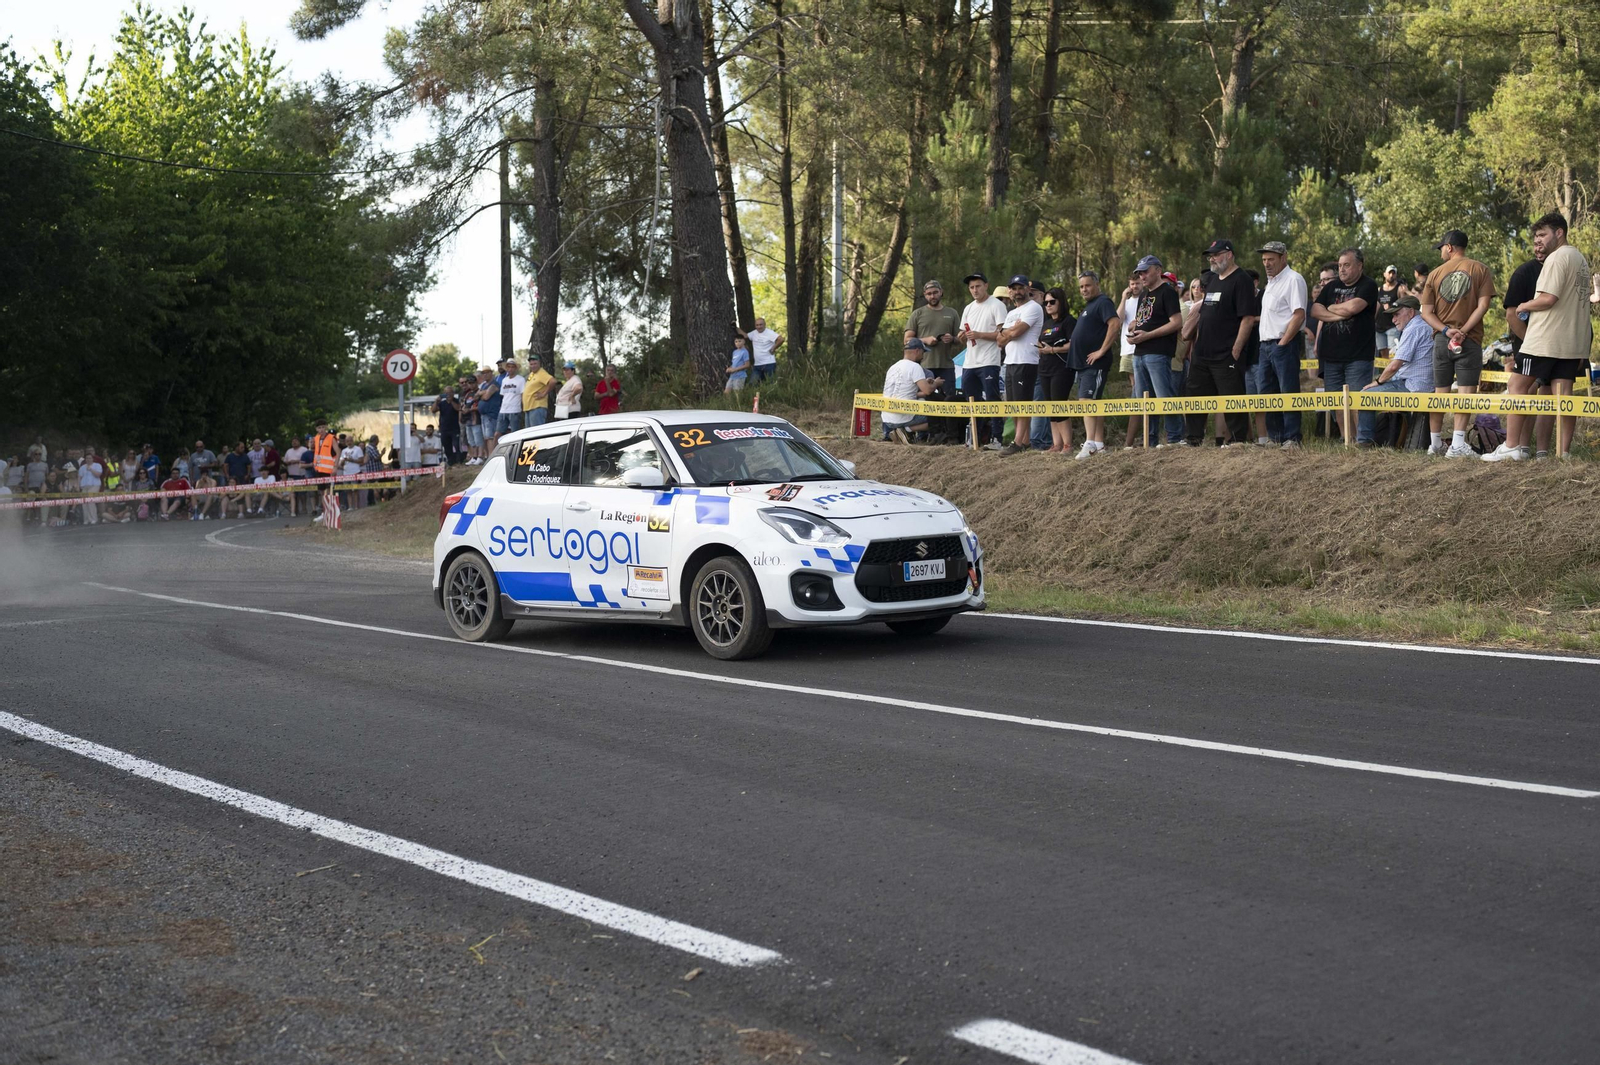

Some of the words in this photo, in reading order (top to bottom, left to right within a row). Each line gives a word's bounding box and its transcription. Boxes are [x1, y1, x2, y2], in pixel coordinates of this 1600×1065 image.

[391, 361, 409, 372] 70
[888, 401, 900, 410] ZONA
[923, 404, 936, 413] ZONA
[976, 405, 999, 414] PUBLICO
[1004, 405, 1019, 413] ZONA
[1021, 405, 1046, 413] PUBLICO
[1051, 404, 1068, 413] ZONA
[1069, 404, 1097, 413] PUBLICO
[1104, 403, 1122, 412] ZONA
[1125, 402, 1155, 411] PUBLCO
[1163, 401, 1183, 411] ZONA
[1185, 400, 1217, 410] PUBLICO
[1226, 400, 1247, 410] ZONA
[1249, 398, 1283, 408] PUBLICO
[1292, 397, 1314, 407] ZONA
[1360, 396, 1382, 407] ZONA
[1384, 397, 1419, 408] PUBLICO
[1428, 398, 1450, 409] ZONA
[1453, 398, 1490, 410] PUBLICO
[1500, 399, 1526, 410] ZONA
[1529, 400, 1573, 412] PUBLCO
[1583, 401, 1600, 413] ZON
[674, 429, 712, 448] 32
[518, 441, 540, 466] 32
[529, 464, 550, 472] M.Cabo
[600, 510, 612, 520] La
[649, 512, 669, 530] 32
[489, 518, 640, 574] sertogal
[911, 564, 928, 576] 2697
[930, 563, 944, 575] KVJ
